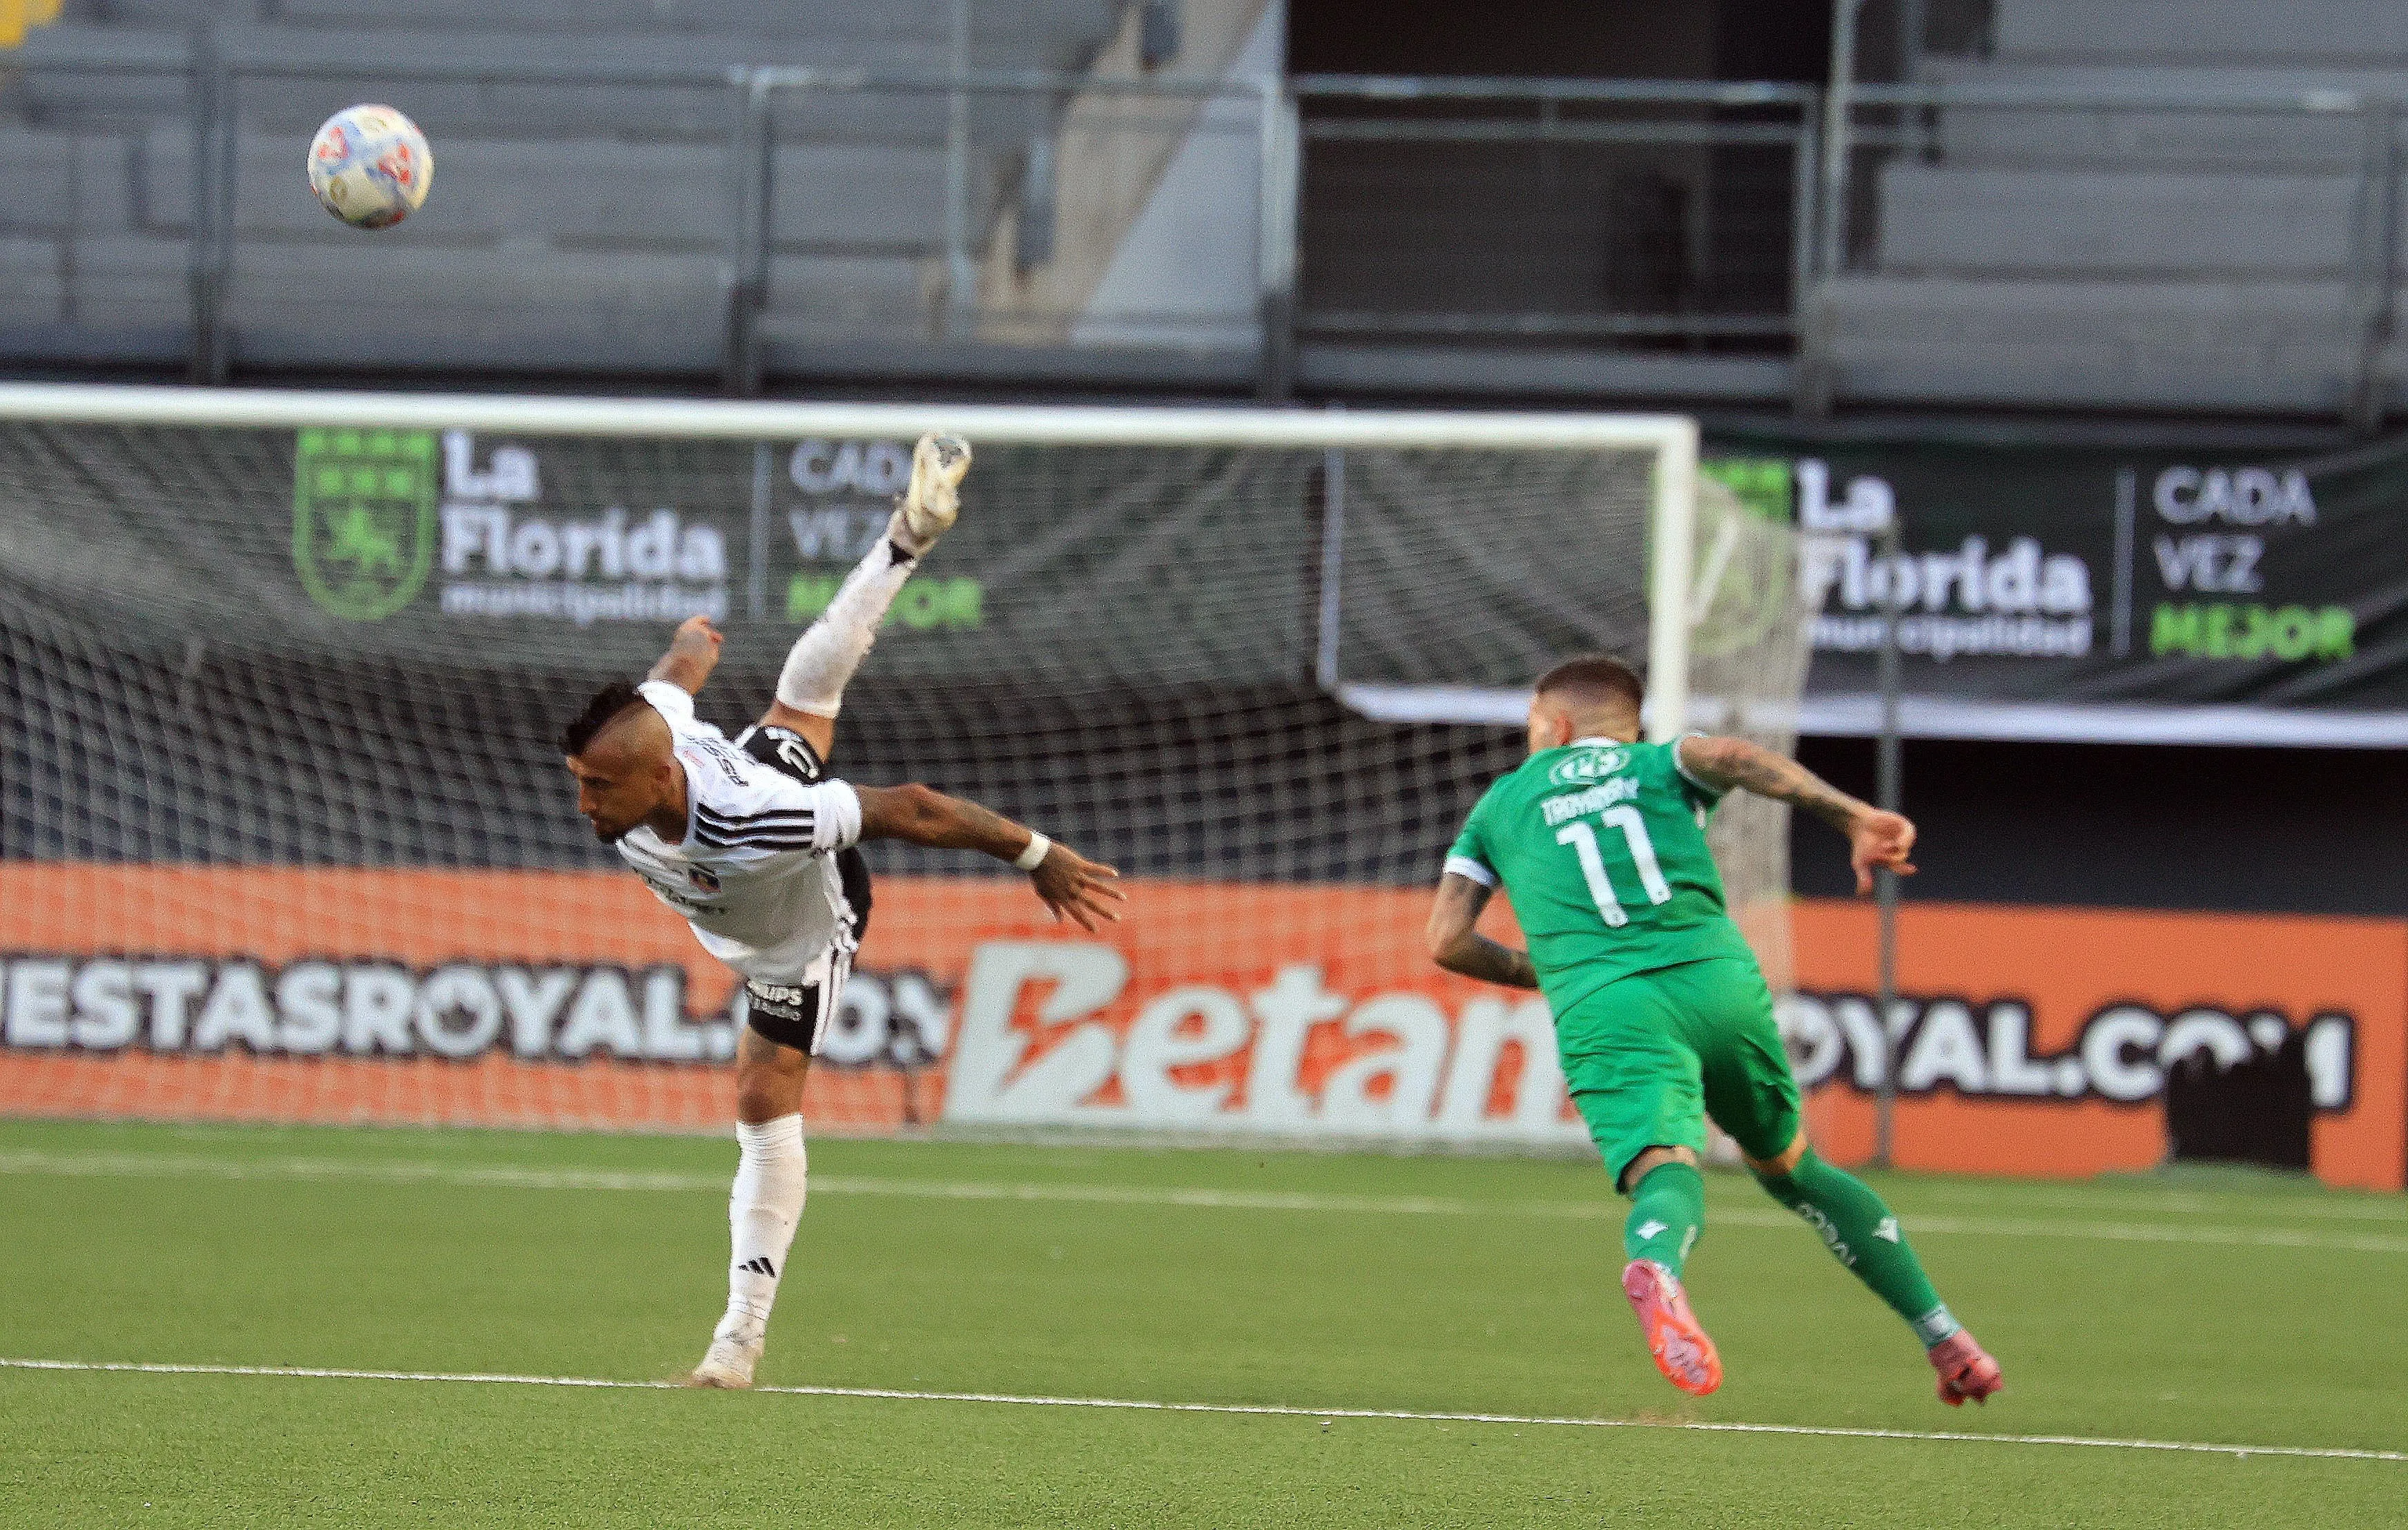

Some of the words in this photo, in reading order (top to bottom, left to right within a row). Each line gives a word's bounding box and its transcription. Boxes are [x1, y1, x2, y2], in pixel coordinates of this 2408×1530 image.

[443, 428, 541, 501] La
[789, 438, 914, 493] CAD
[1795, 456, 1896, 532] La
[2153, 465, 2318, 526] CADA
[2153, 532, 2266, 594] VEZ
[786, 573, 986, 631] MOR
[2150, 602, 2356, 663] MEJOR
[1805, 614, 2095, 660] muncipalidad
[1555, 804, 1673, 927] 11
[946, 939, 1571, 1132] Betan
